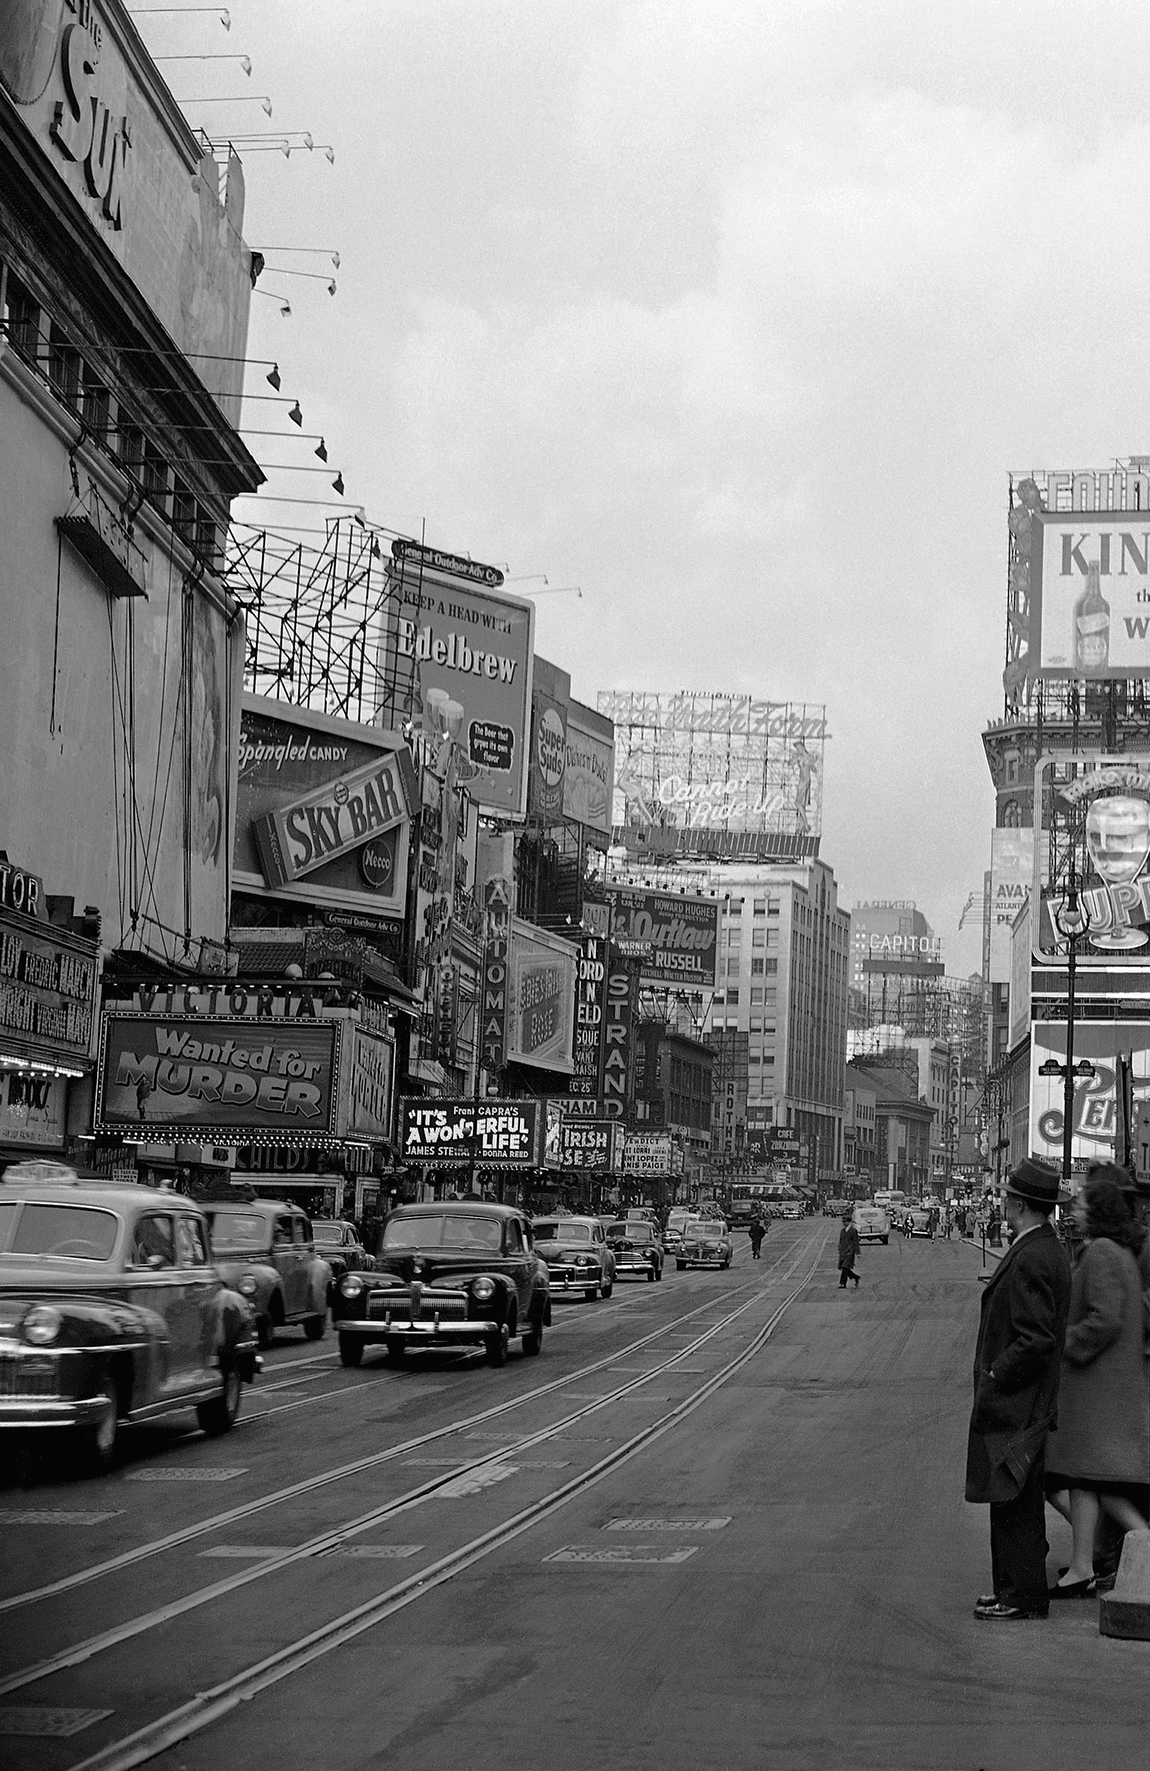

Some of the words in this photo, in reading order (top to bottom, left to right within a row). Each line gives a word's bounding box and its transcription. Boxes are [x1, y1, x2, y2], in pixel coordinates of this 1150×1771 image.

[435, 553, 468, 573] Outdoor
[468, 565, 485, 578] Adv
[403, 591, 434, 611] KEEP
[437, 601, 445, 615] A
[449, 603, 480, 624] HEAD
[480, 613, 511, 634] WITH
[400, 618, 518, 684] Edelbrew
[474, 725, 484, 735] The
[539, 718, 566, 753] Super
[239, 732, 311, 770] Spangled
[309, 747, 348, 761] CANDY
[539, 744, 562, 775] Suds
[286, 807, 345, 870] SKY
[347, 768, 401, 839] BAR
[365, 850, 391, 870] Necco
[654, 899, 683, 914] HOWARD
[685, 905, 716, 919] HUGHES
[630, 910, 715, 951] Outlaw
[870, 934, 940, 953] CAPITOL
[618, 942, 651, 951] WARNER
[656, 951, 703, 972] RUSSELL
[24, 951, 59, 991] FREDRIC
[59, 954, 94, 1000] MARCH
[485, 884, 511, 1061] AUTOMAT
[139, 984, 316, 1017] VICTORIA
[155, 1027, 273, 1073] Wanted
[277, 1050, 321, 1080] for
[603, 974, 629, 1116] STRAND
[115, 1051, 323, 1118] MURDER
[478, 1106, 519, 1117] CAPRA'S
[726, 1082, 736, 1152] ROTHS
[405, 1127, 421, 1145] A
[423, 1116, 529, 1143] WONDERFUL
[482, 1134, 529, 1150] LIFE"
[564, 1129, 607, 1148] IRISH
[777, 1130, 794, 1139] CAFE
[236, 1146, 310, 1170] CHILDS
[405, 1146, 435, 1156] JAMES
[438, 1146, 478, 1157] STEWAT
[509, 1150, 529, 1158] REED
